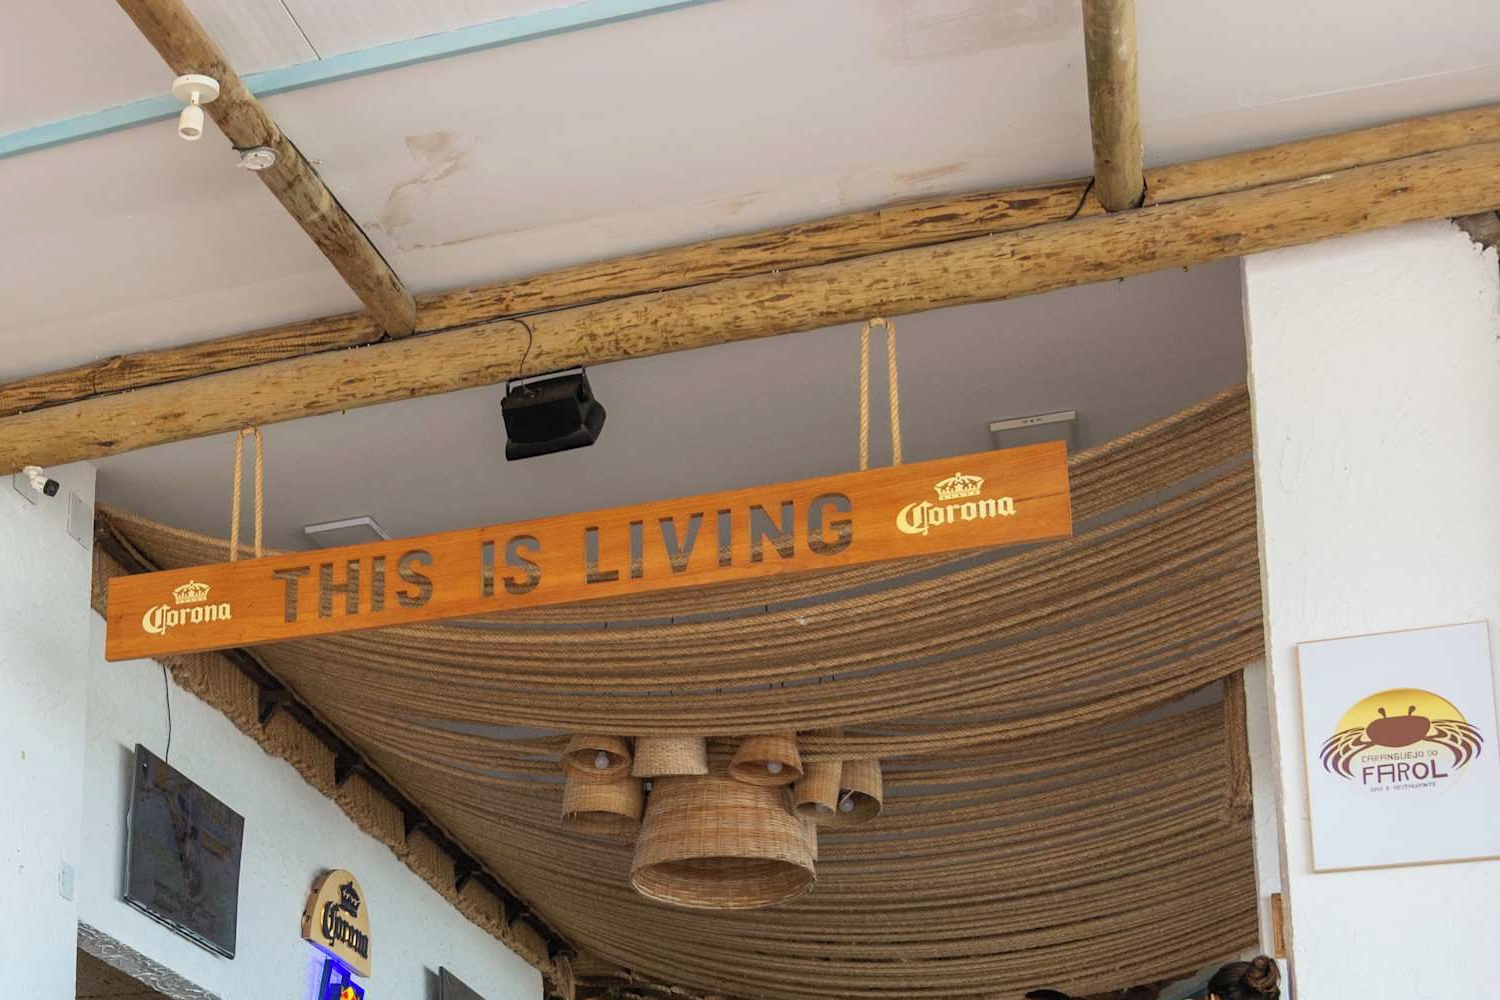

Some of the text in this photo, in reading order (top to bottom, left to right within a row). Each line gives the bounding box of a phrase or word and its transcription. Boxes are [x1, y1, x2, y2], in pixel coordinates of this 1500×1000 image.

[896, 496, 1017, 536] Corona
[272, 492, 853, 624] THIS IS LIVING
[142, 603, 232, 635] Corona
[1362, 759, 1448, 785] FAROL
[321, 900, 369, 960] Corona
